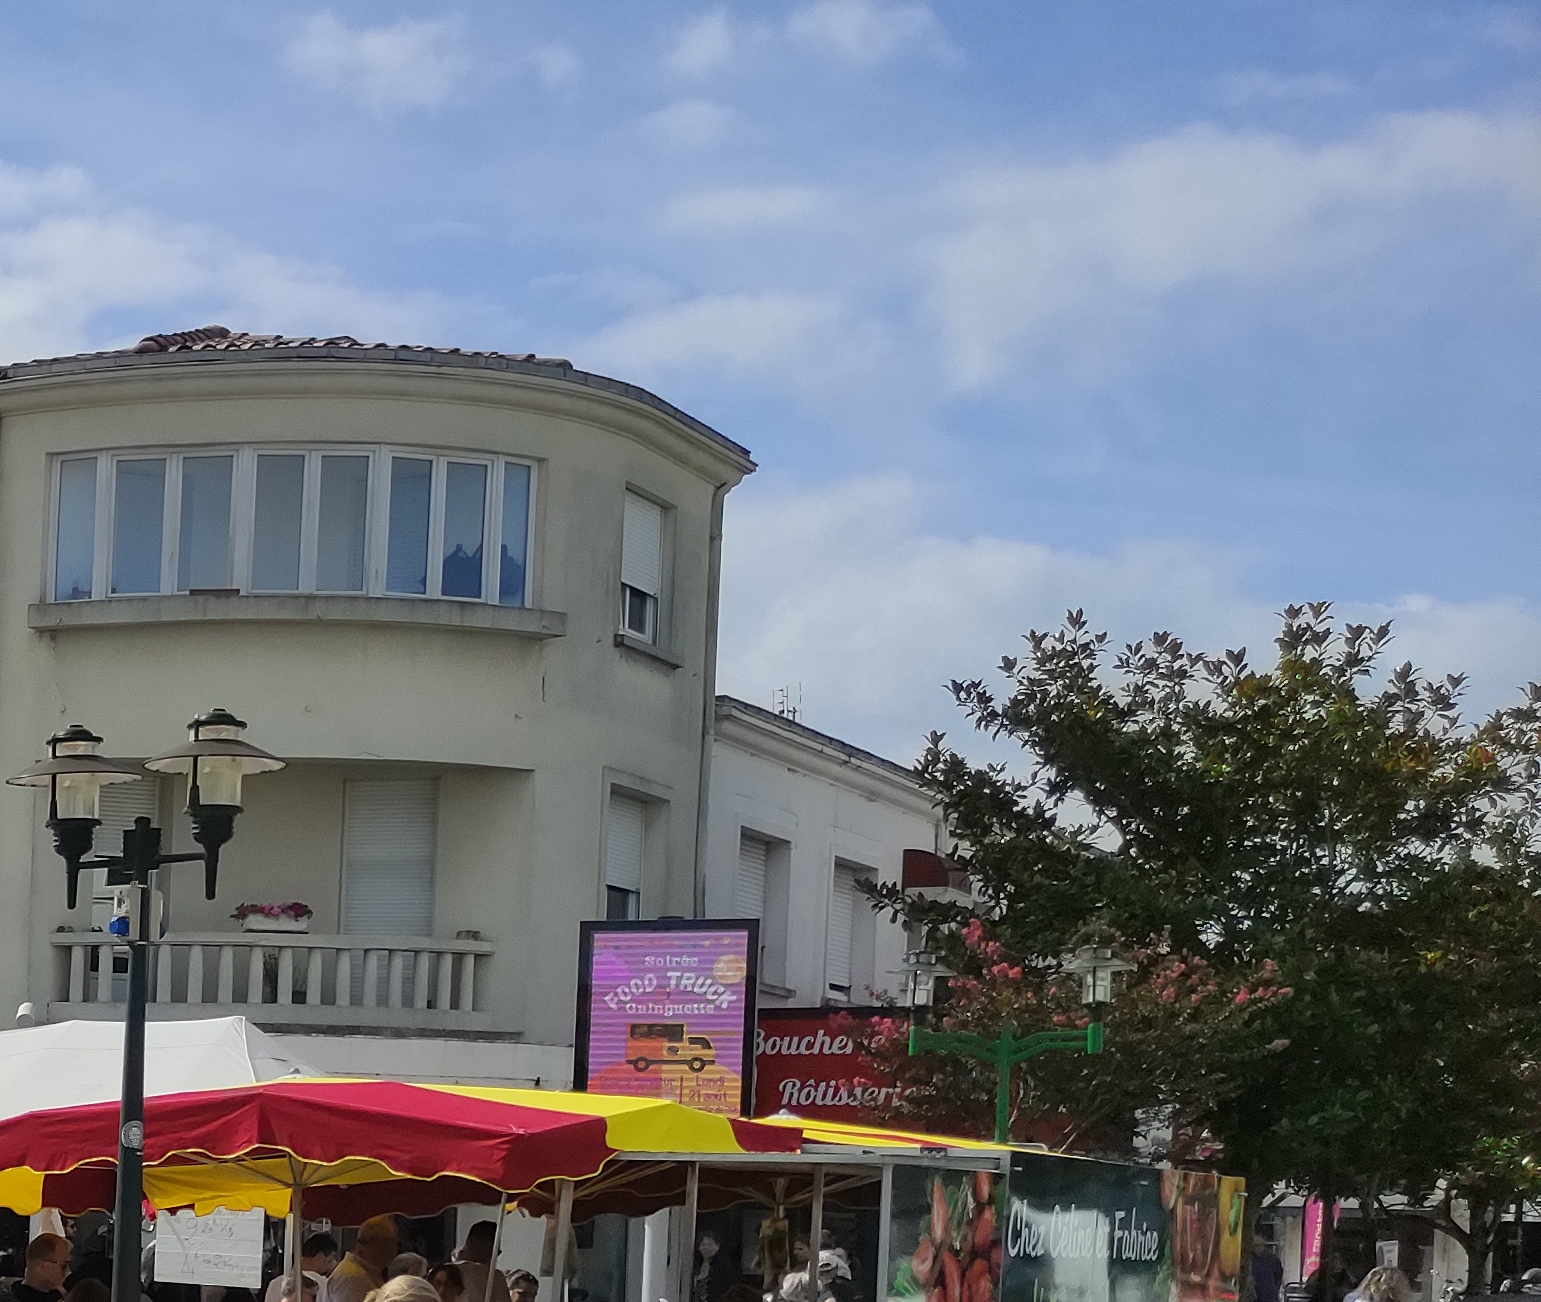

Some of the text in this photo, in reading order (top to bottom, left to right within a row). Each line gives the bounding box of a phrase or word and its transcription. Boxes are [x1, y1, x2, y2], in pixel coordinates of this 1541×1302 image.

[644, 955, 699, 968] Soirée
[603, 971, 737, 1011] FOOD TRUCK
[625, 1003, 715, 1016] Guinguette
[754, 1028, 887, 1056] Bouchere
[1007, 1197, 1046, 1258] Chez
[1113, 1206, 1159, 1261] Fabrice
